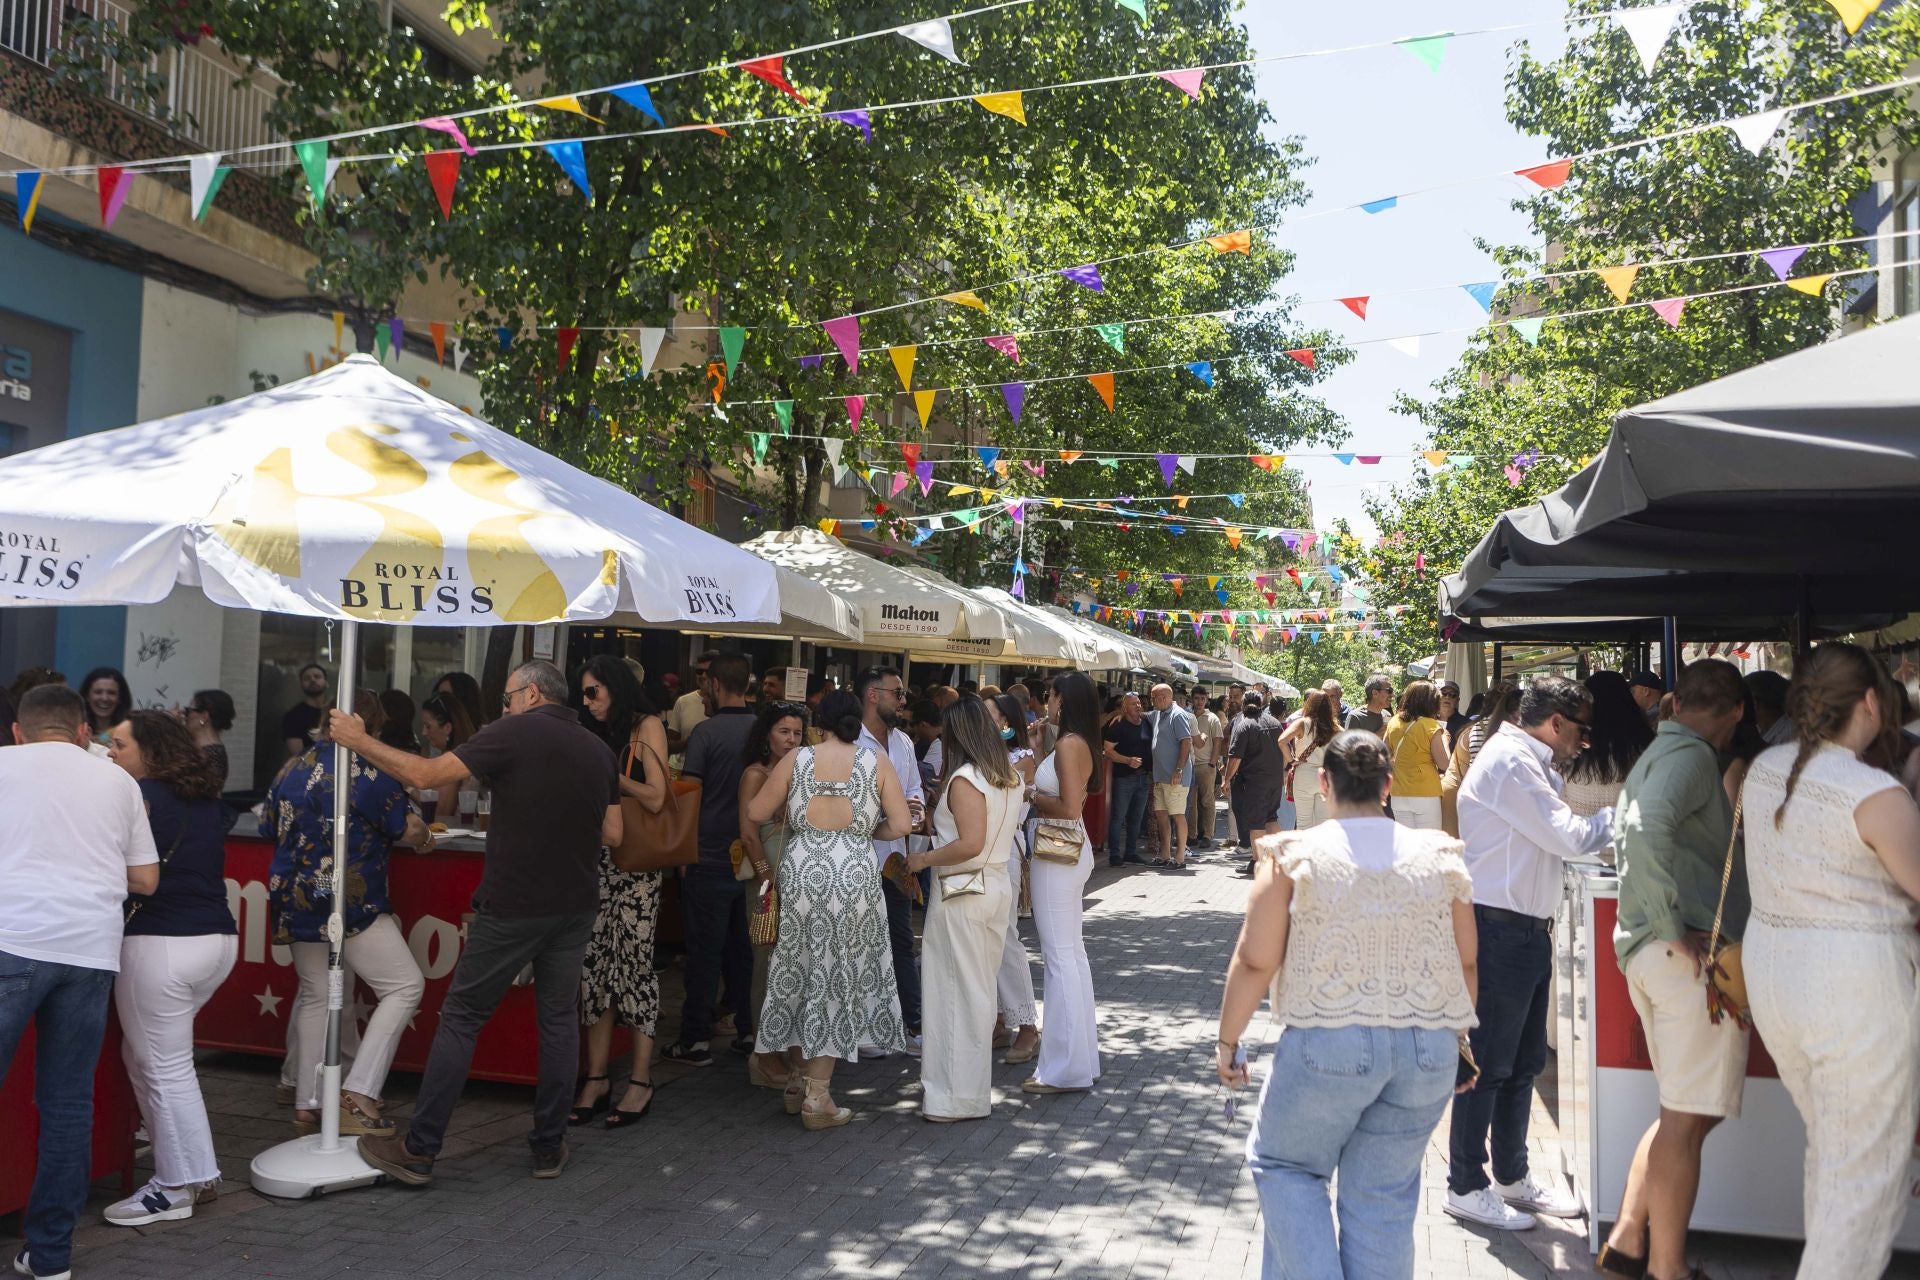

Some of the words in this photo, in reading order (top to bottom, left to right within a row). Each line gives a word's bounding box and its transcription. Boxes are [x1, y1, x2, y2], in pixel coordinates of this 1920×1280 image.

[0, 344, 32, 381] a
[0, 551, 84, 590] ISS
[375, 562, 459, 581] ROYAL
[339, 578, 494, 614] BLISS
[881, 603, 940, 622] Mahou
[880, 622, 911, 631] DESDE
[916, 624, 938, 633] 1890
[946, 644, 969, 652] DESDE
